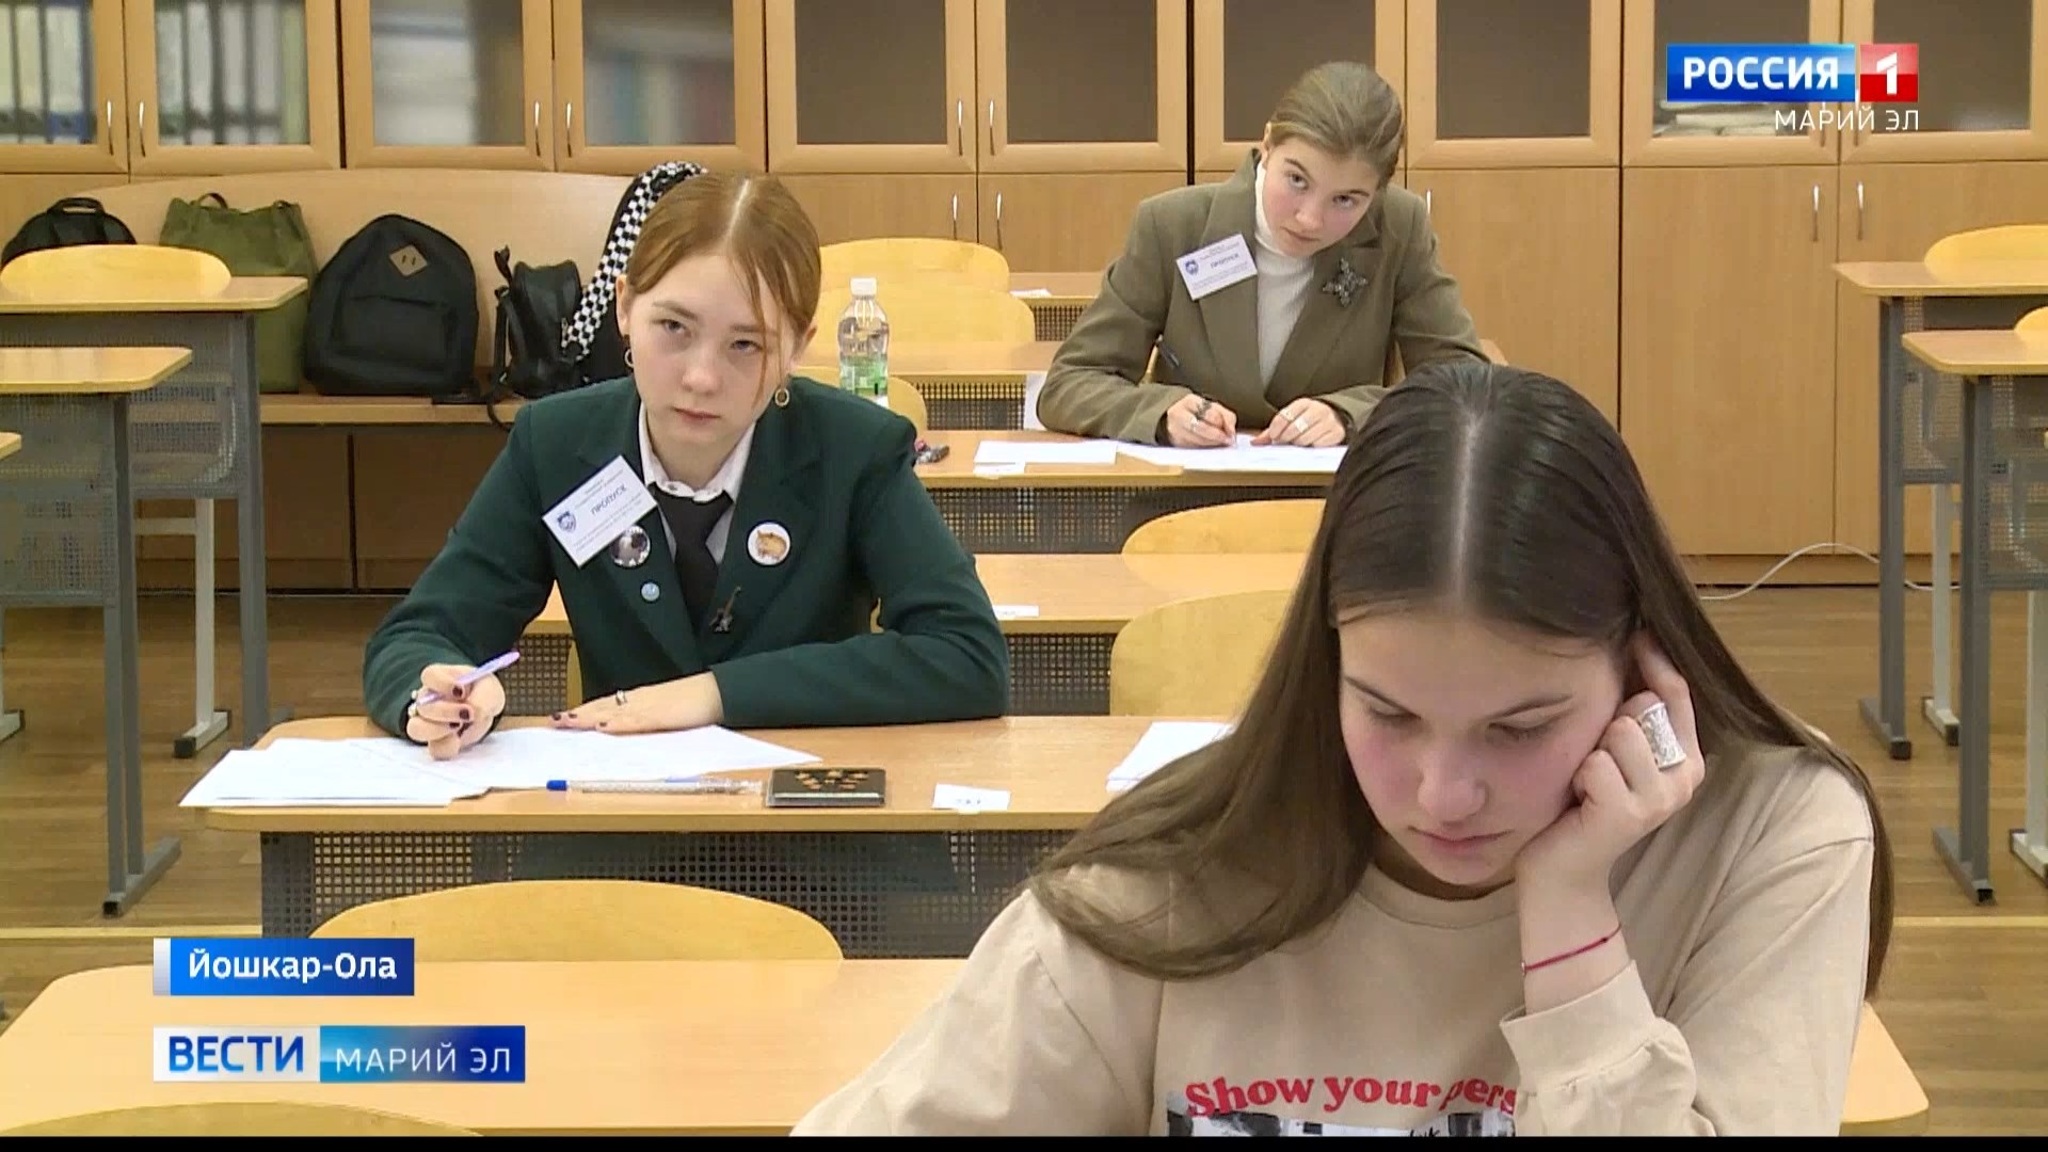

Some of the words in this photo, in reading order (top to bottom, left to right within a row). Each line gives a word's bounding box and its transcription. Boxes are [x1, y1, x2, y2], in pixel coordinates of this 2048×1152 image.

[590, 484, 628, 516] ПРОПУСК
[1185, 1076, 1315, 1117] Show
[1323, 1077, 1441, 1112] your
